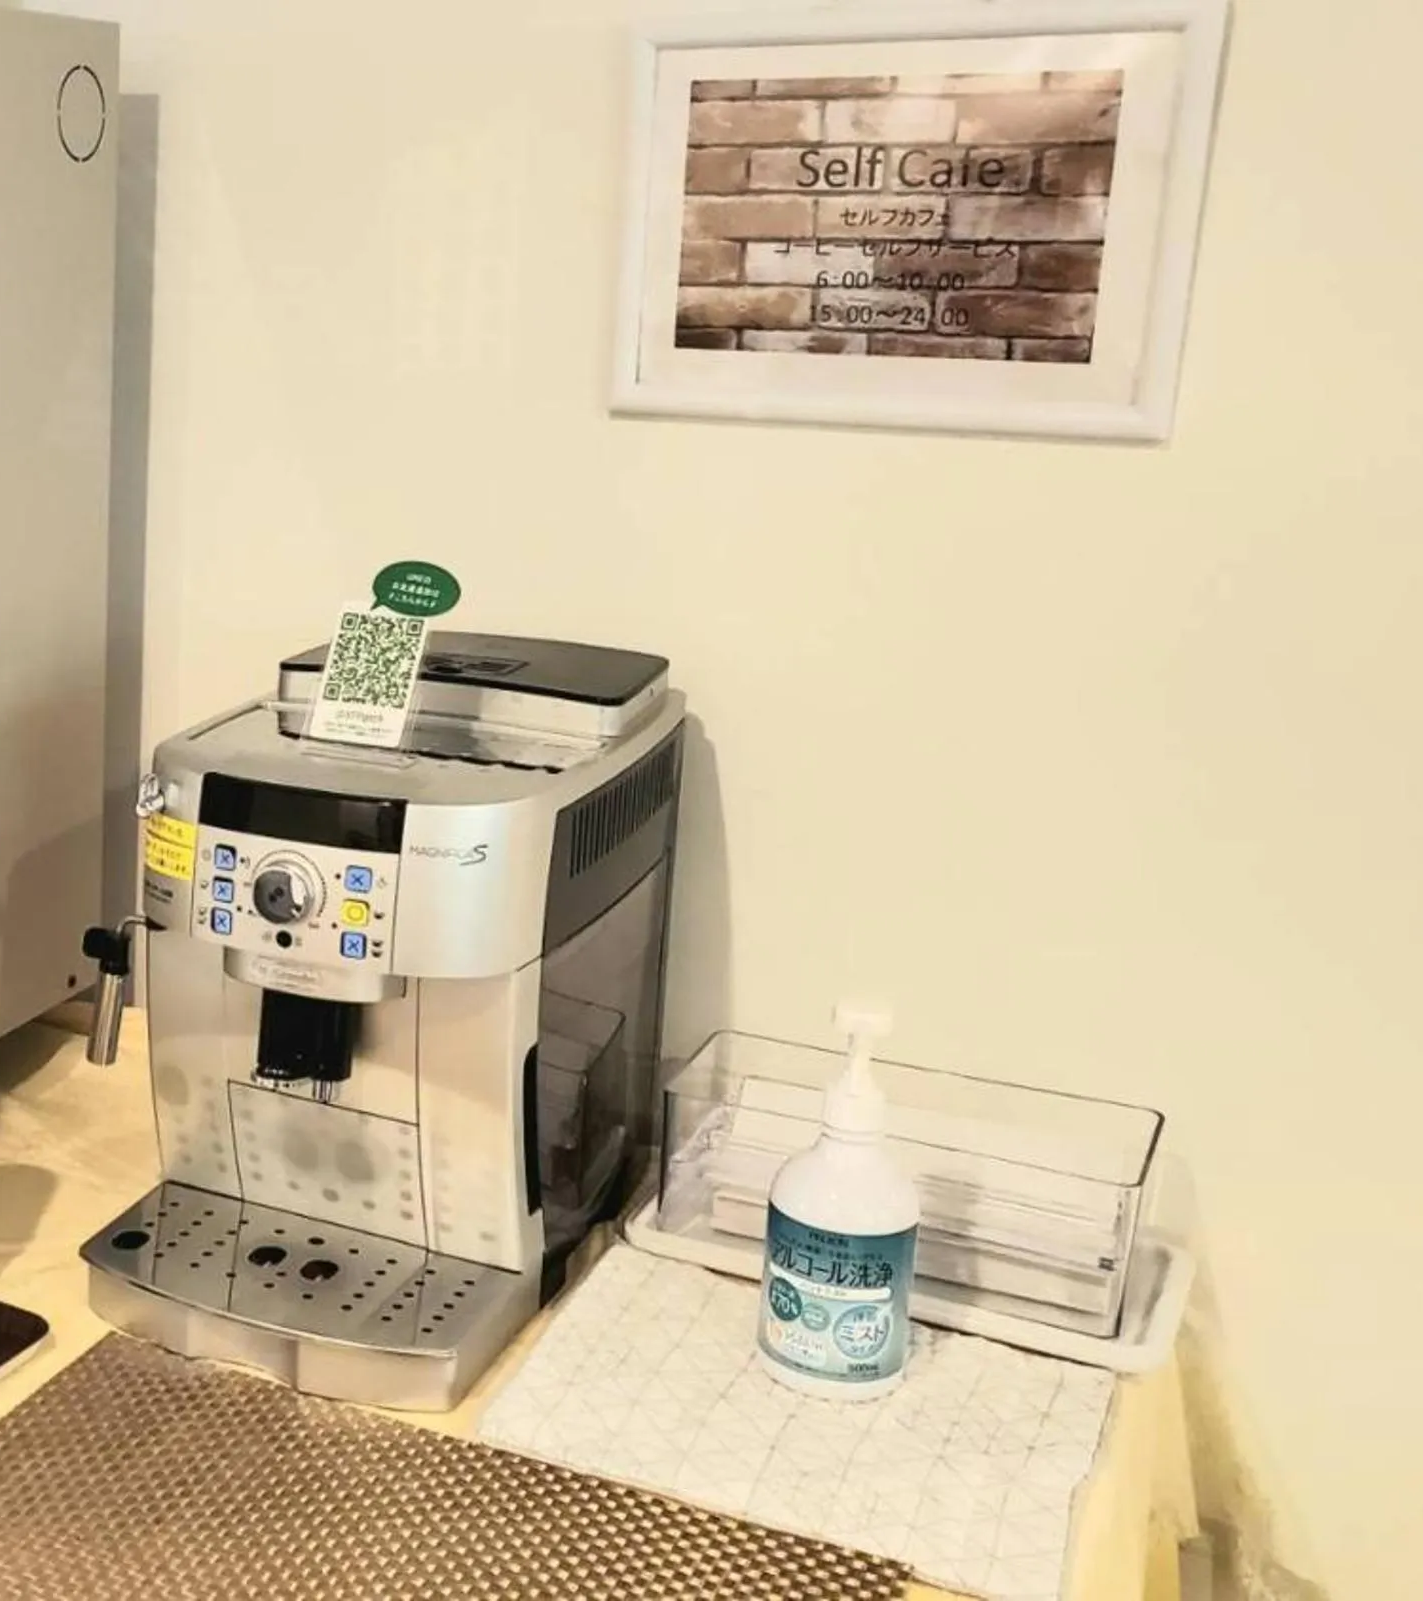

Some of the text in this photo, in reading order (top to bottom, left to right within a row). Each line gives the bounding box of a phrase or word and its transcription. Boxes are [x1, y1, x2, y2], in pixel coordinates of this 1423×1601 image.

[795, 146, 1005, 188] Self Cafe
[840, 207, 950, 227] セルフカフェ
